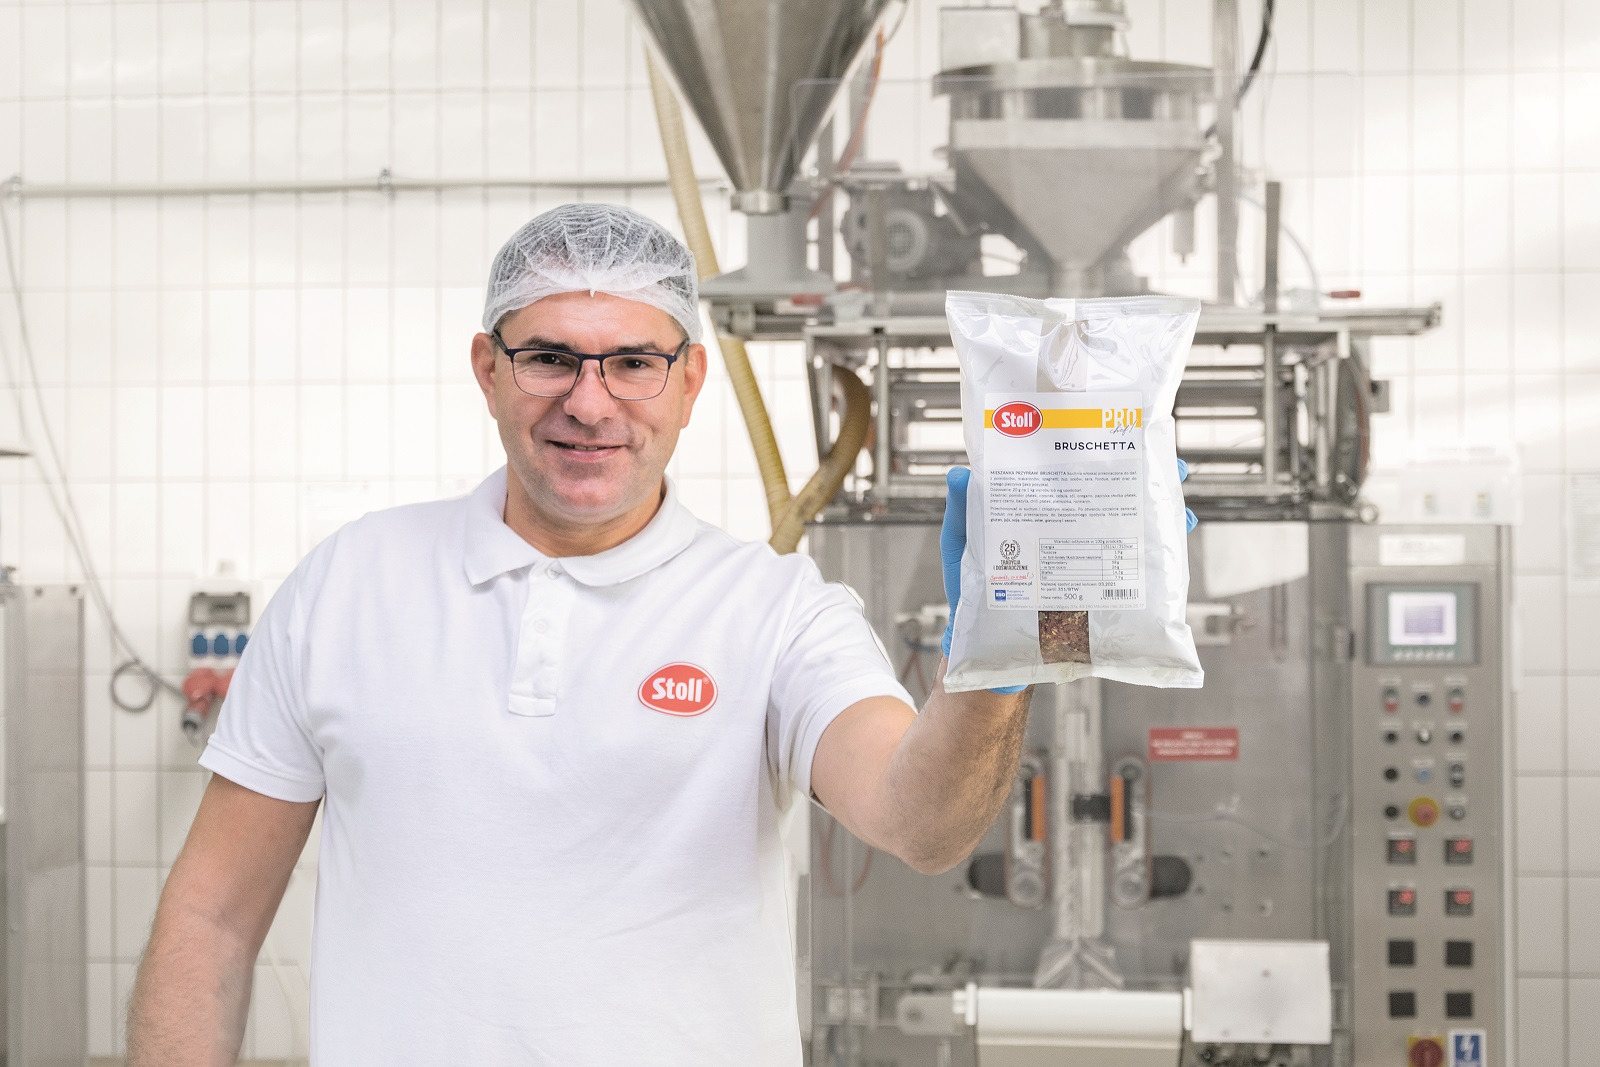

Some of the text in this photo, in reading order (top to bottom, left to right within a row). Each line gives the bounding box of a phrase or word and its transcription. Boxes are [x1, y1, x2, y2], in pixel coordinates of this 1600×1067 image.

[1001, 411, 1033, 428] Stoll
[1101, 408, 1138, 428] PRO
[1054, 441, 1136, 450] BRUSCHETTA
[1004, 543, 1016, 552] 25
[651, 677, 703, 703] Stoll
